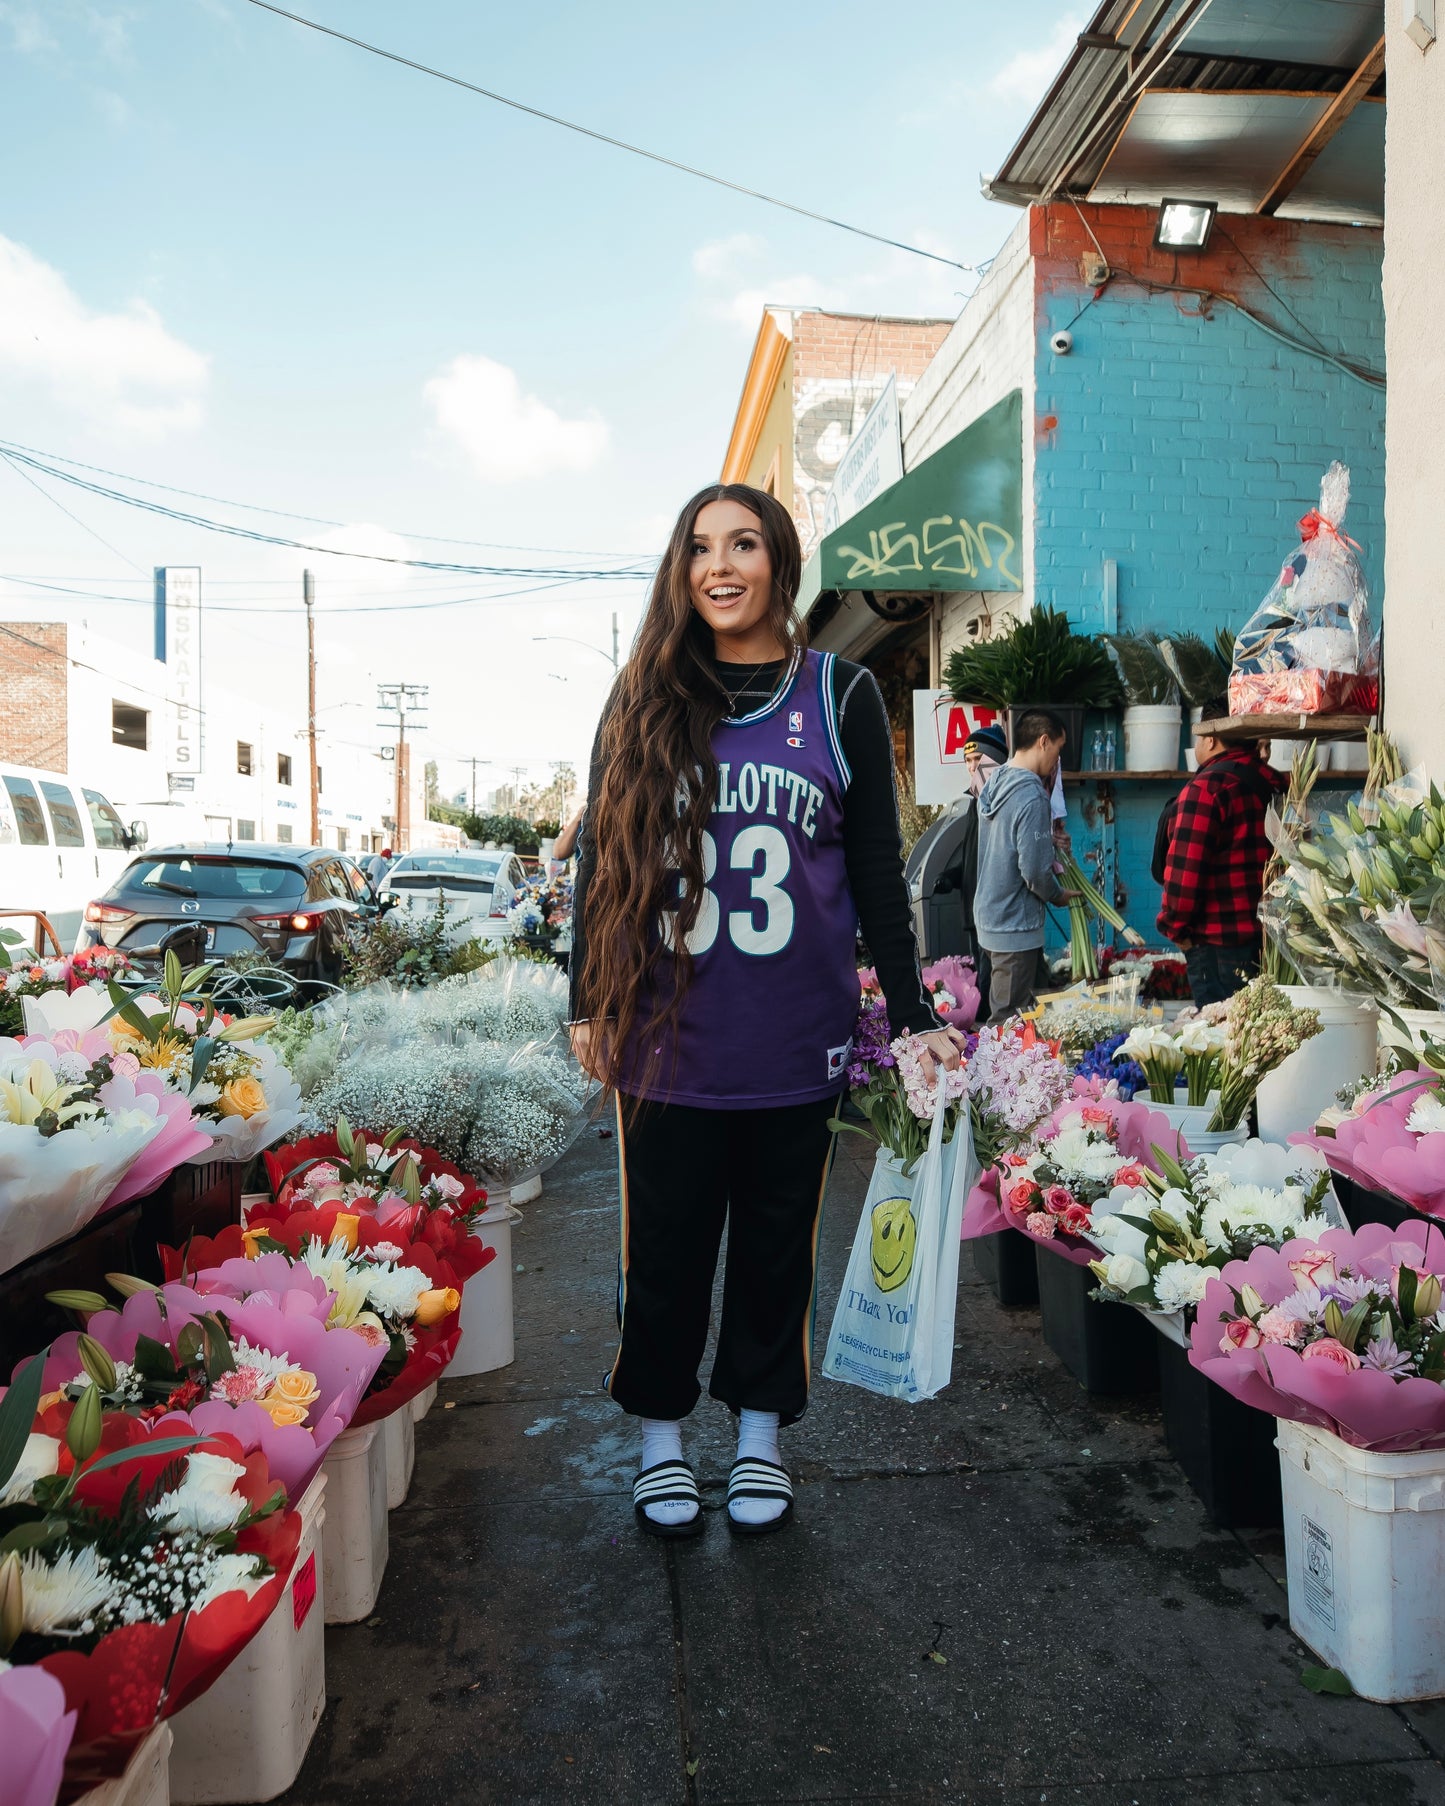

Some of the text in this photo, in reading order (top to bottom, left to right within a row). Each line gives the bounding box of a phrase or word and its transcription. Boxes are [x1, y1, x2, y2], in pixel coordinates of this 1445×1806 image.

[173, 574, 193, 762] MOSKATELS
[673, 761, 825, 839] ALOTTE
[658, 823, 795, 957] 33
